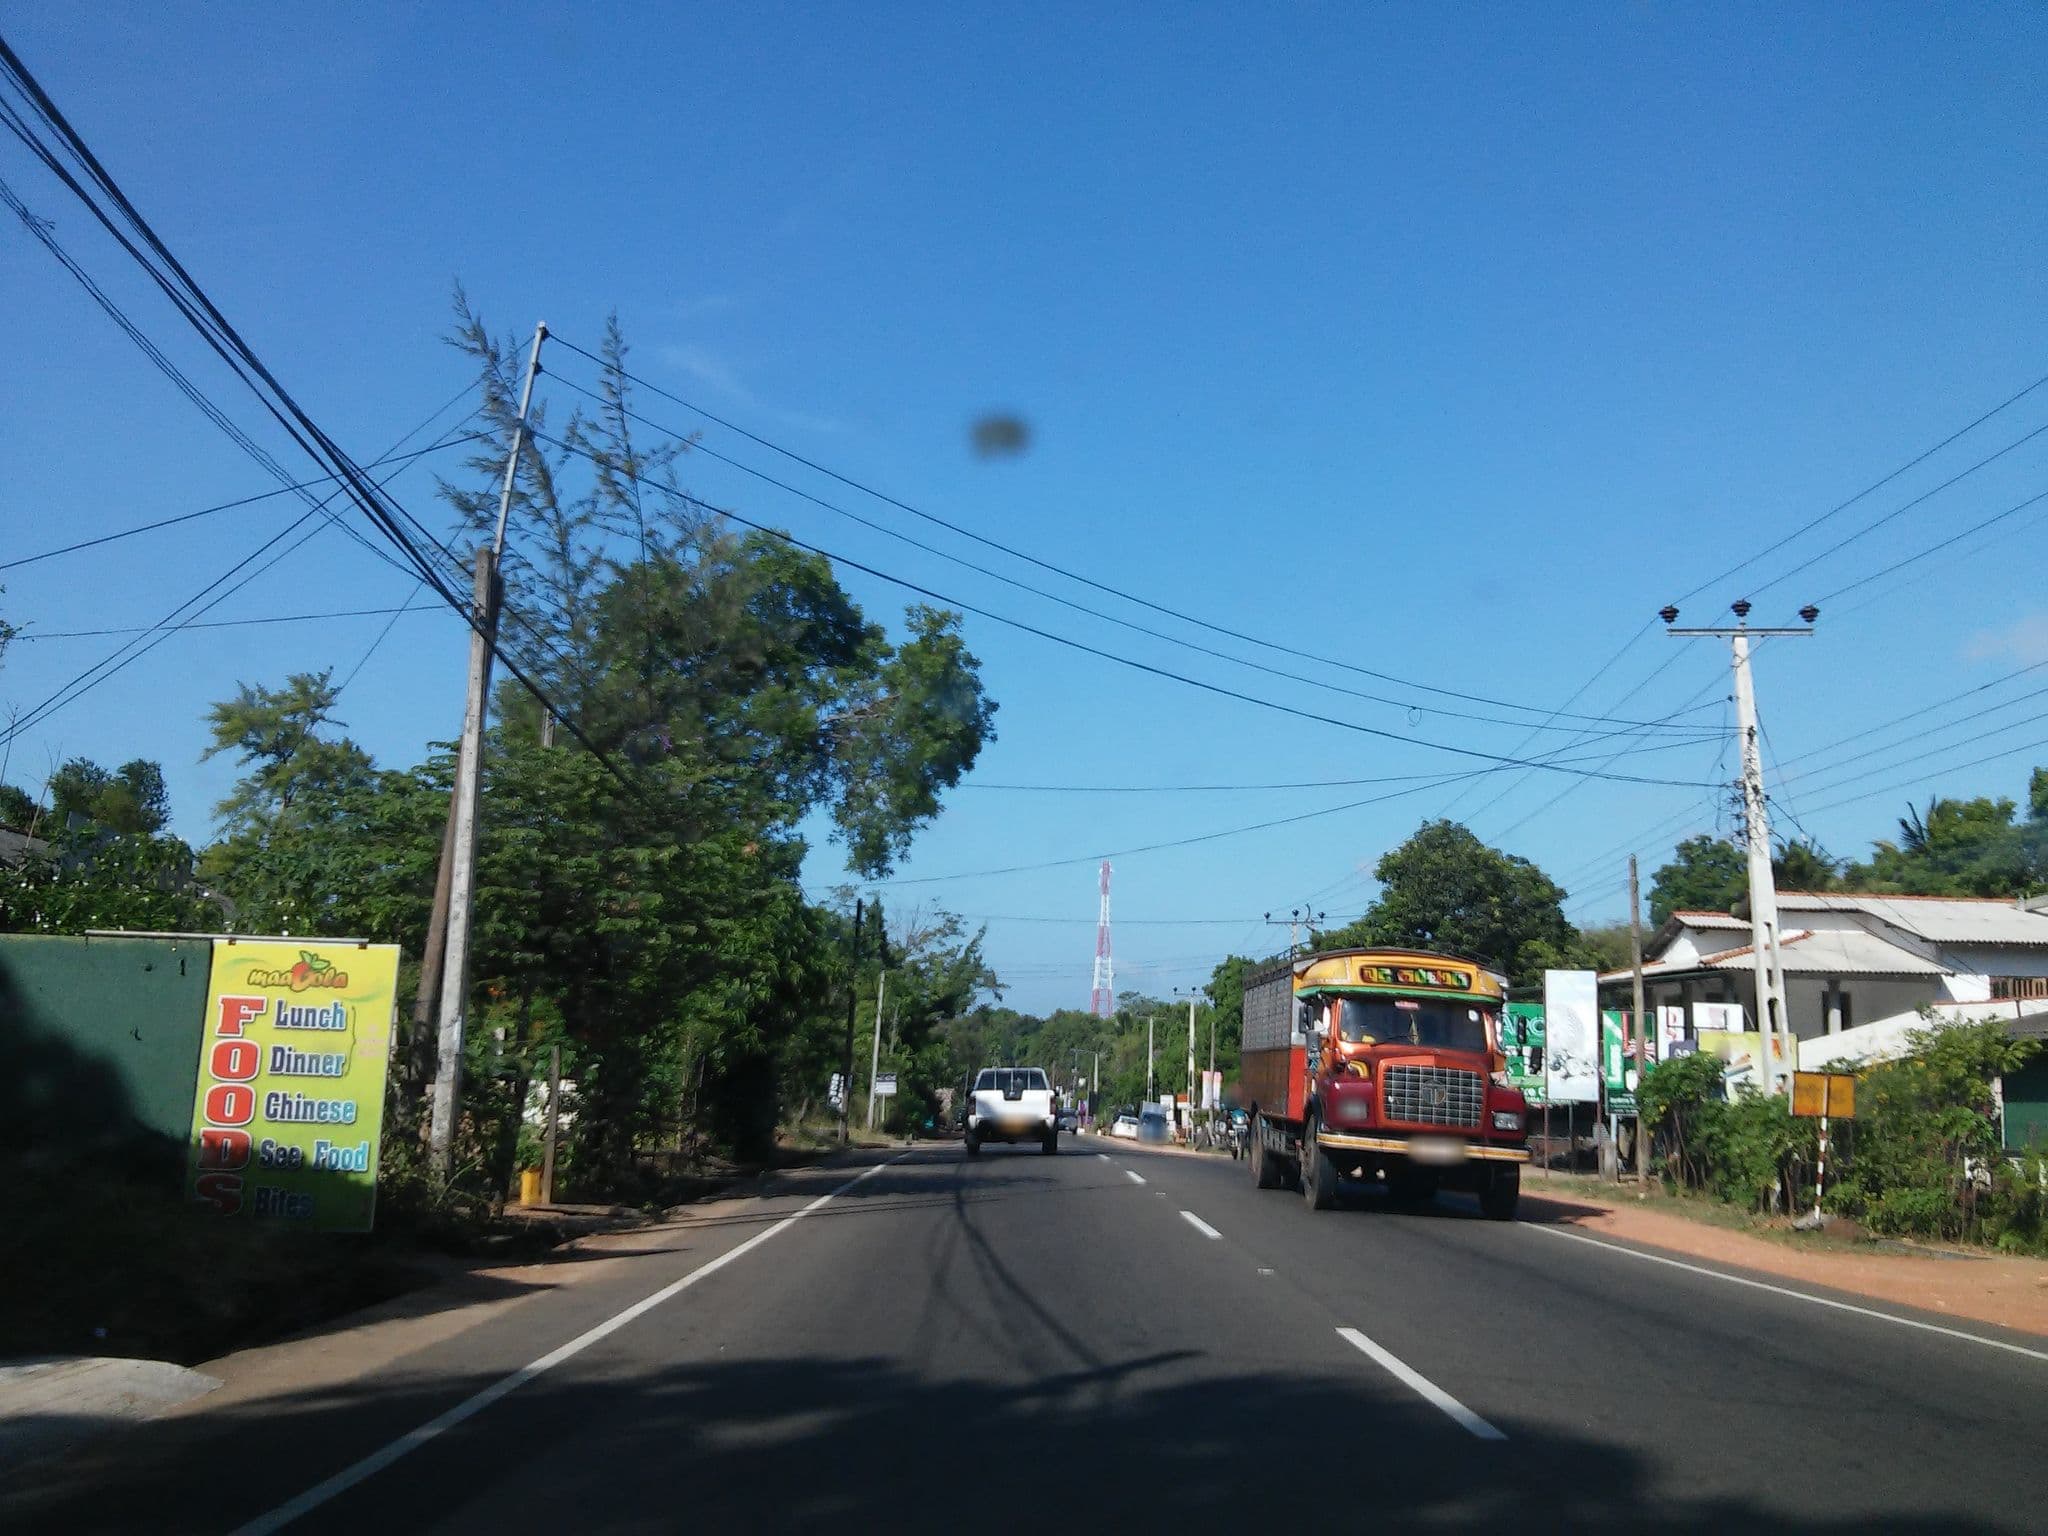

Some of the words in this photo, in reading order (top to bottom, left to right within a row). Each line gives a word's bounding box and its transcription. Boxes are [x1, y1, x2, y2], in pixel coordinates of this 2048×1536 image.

[274, 999, 347, 1031] Lunch
[268, 1046, 346, 1077] Dinner
[195, 995, 267, 1217] FOODS
[263, 1091, 356, 1124] Chinese
[259, 1137, 302, 1168] See
[312, 1139, 369, 1172] Food
